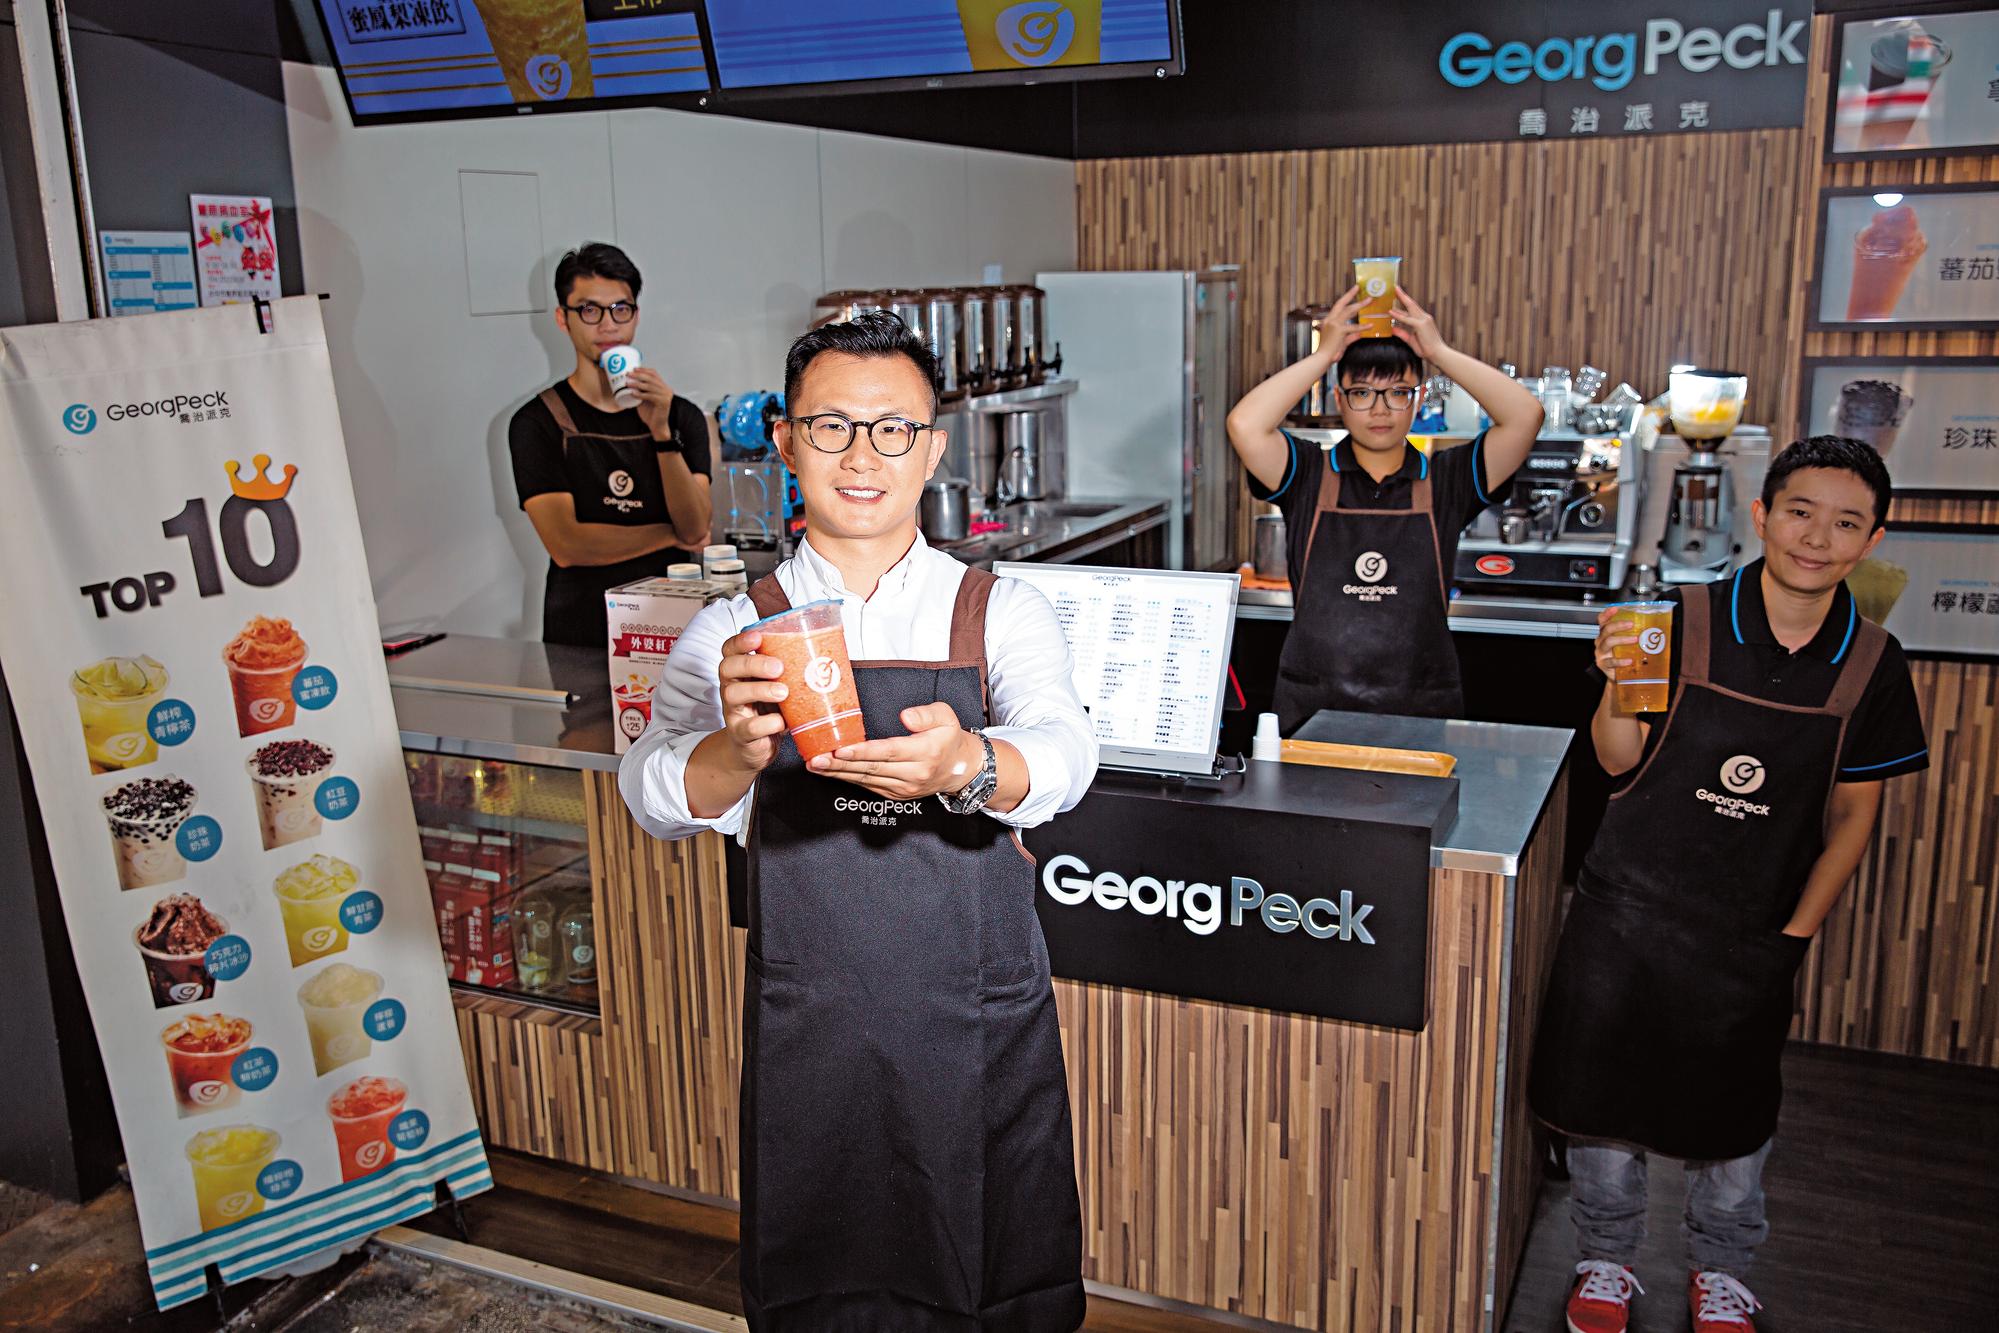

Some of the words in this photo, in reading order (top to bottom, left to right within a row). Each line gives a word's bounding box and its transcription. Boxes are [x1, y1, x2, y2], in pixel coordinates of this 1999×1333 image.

[347, 0, 454, 33] 蜜鳳梨凍飲
[1439, 8, 1806, 91] GeorgPeck
[1518, 101, 1710, 136] 喬治派克
[1939, 256, 1999, 282] 蕃茄
[106, 391, 229, 421] GeorgPeck
[179, 408, 232, 424] 喬治派克
[1942, 427, 1998, 450] 珍珠
[80, 571, 176, 619] TOP
[161, 494, 301, 598] 10
[1342, 584, 1398, 595] GeorgPeck
[328, 797, 350, 811] 奶茶
[834, 797, 922, 816] GeorgPeck
[1696, 788, 1771, 816] GeorgPeck
[861, 815, 897, 826] 喬治派克
[1042, 854, 1375, 945] GeorgPeck
[211, 944, 242, 960] 巧克力
